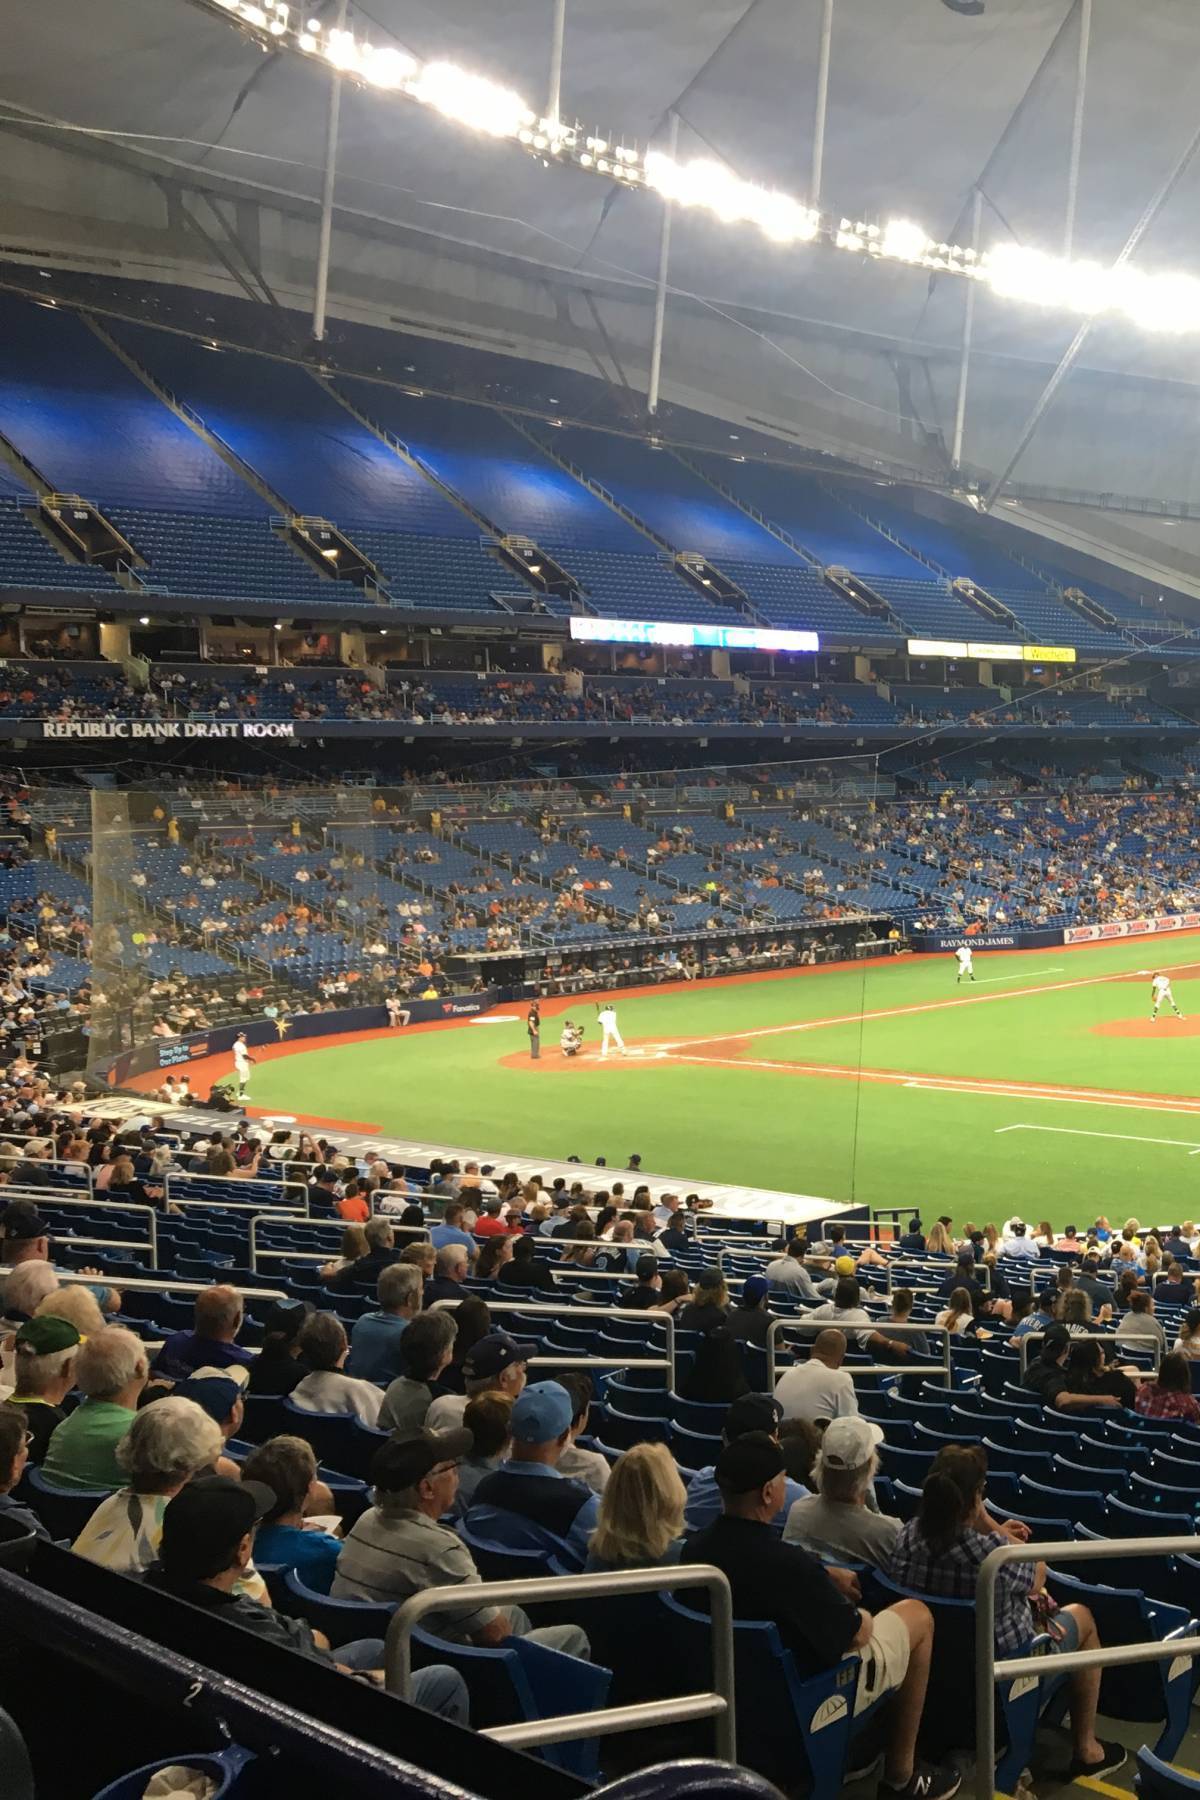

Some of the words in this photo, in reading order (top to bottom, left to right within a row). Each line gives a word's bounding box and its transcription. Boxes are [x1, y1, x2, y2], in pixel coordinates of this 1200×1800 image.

[43, 723, 130, 738] REPUBLIC
[131, 723, 181, 738] BANK
[184, 723, 238, 738] DRAFT
[243, 723, 294, 737] ROOM
[940, 937, 985, 948] RAYMOND
[985, 937, 1014, 946] JAMES
[452, 1003, 481, 1013] Fanatics
[182, 1682, 203, 1708] 2
